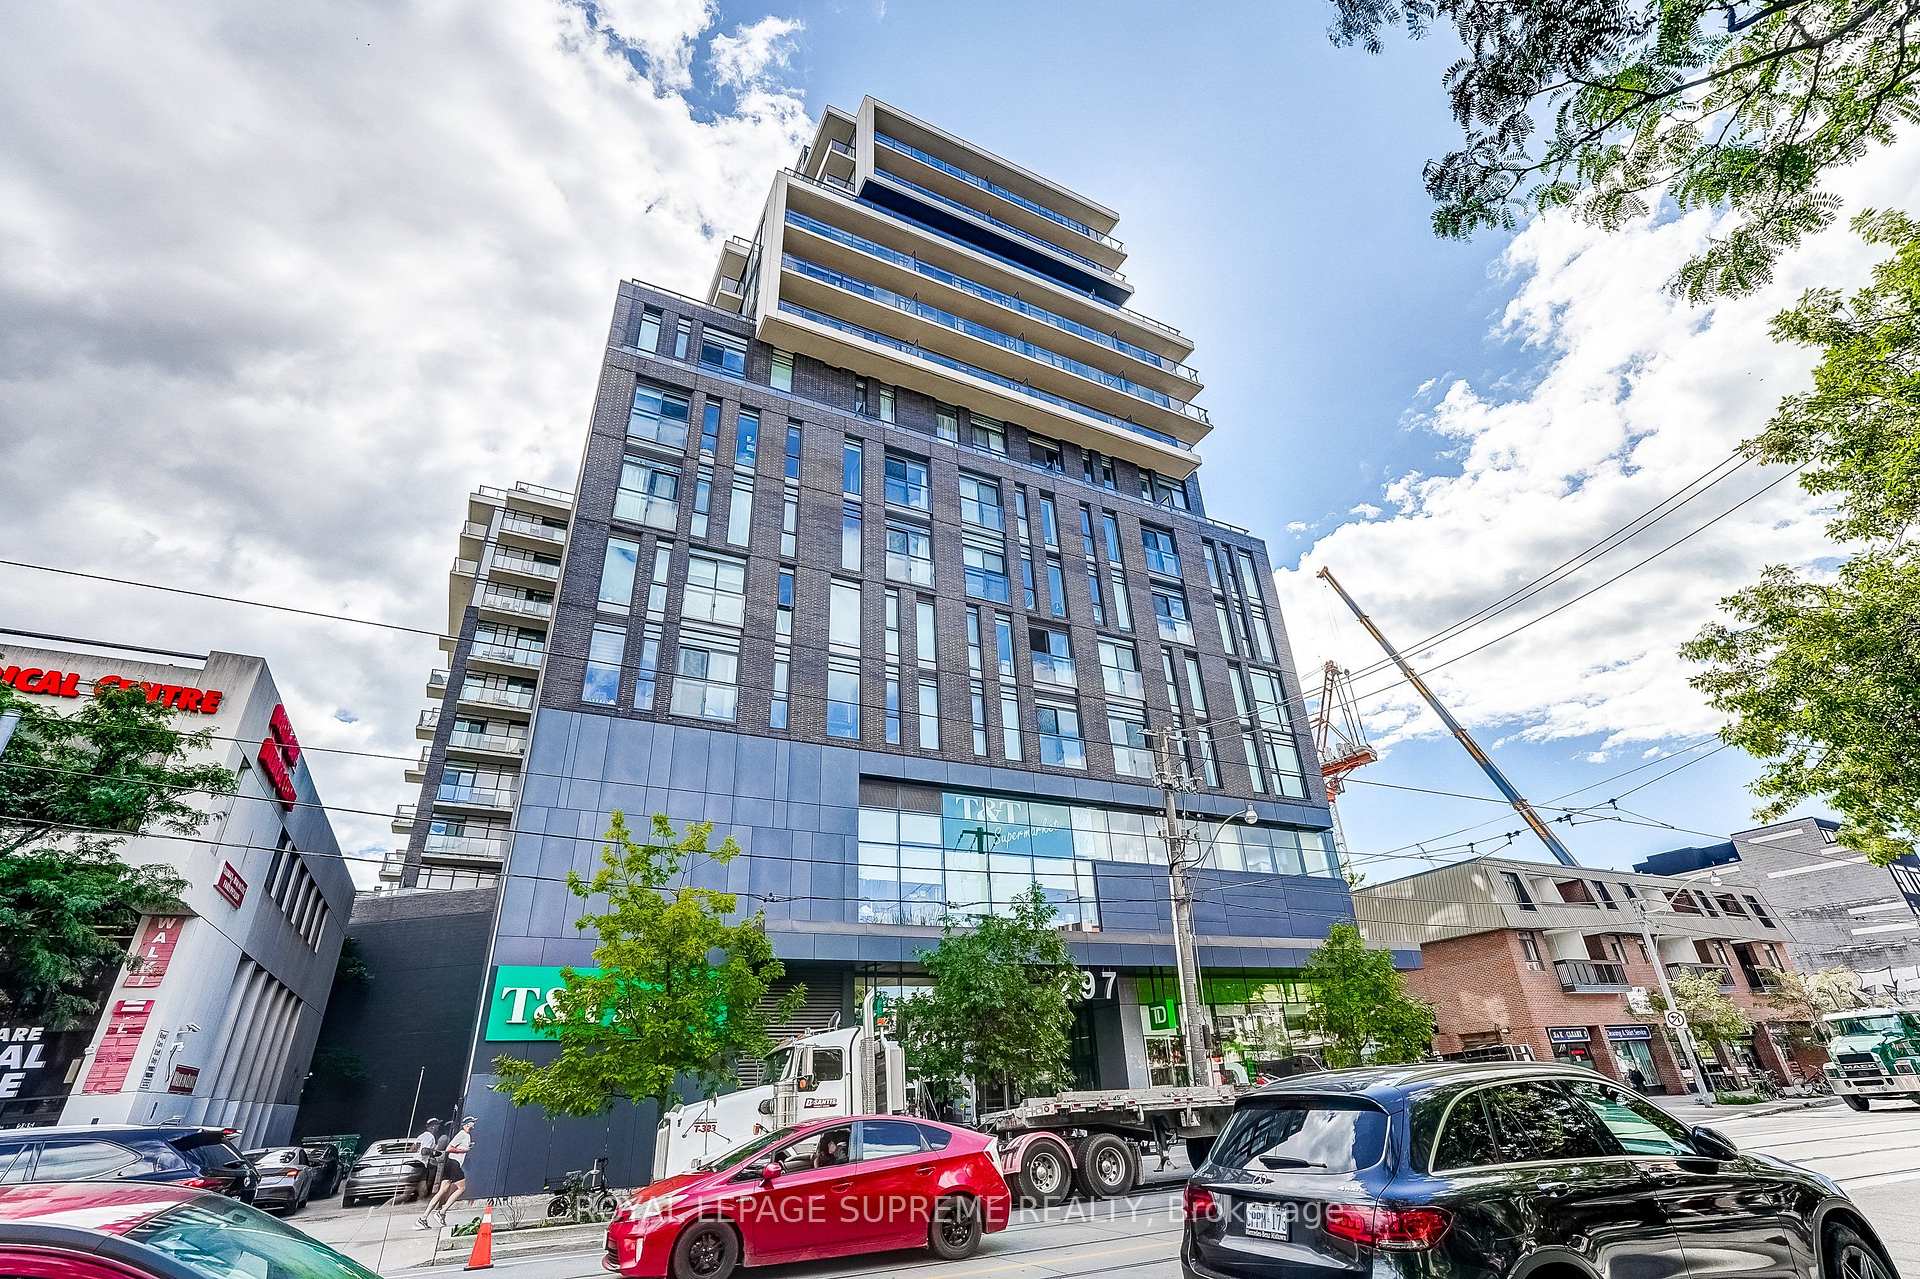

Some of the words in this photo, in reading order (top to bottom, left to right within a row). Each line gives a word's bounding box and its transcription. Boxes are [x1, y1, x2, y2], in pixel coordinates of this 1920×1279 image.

[0, 665, 80, 698] ICAL
[955, 797, 1021, 823] T&T
[994, 817, 1059, 849] Supermarket
[501, 987, 602, 1024] T&
[1150, 1005, 1167, 1024] TD
